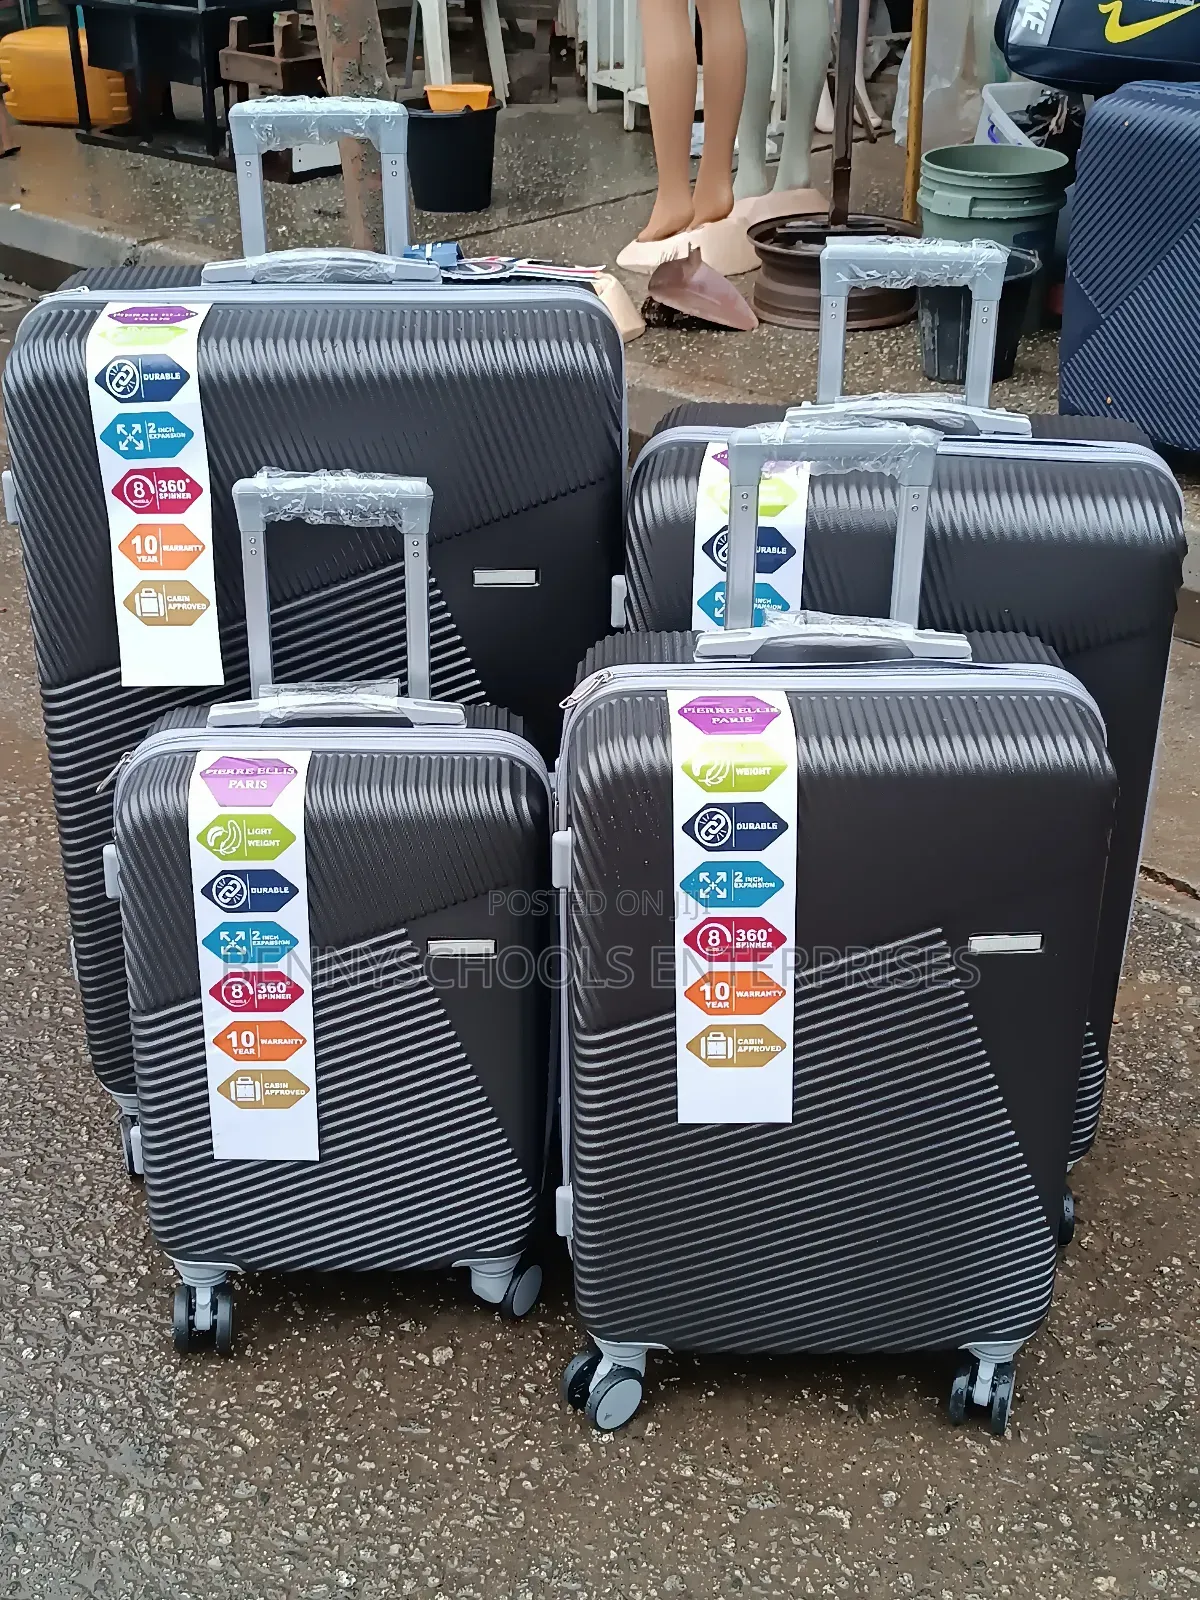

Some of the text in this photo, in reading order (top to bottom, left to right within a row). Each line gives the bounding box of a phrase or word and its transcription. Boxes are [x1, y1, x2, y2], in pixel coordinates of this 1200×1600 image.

[1021, 0, 1051, 35] KE
[143, 372, 181, 381] DURABLE
[148, 422, 157, 433] 2
[148, 432, 186, 440] EXPANSION
[133, 481, 146, 498] 8
[158, 492, 192, 500] SPINNER
[131, 535, 158, 555] 10
[162, 544, 203, 552] WARRANTY
[756, 546, 787, 554] URABLE
[136, 555, 158, 563] YEAR
[168, 602, 207, 610] APPROVED
[683, 706, 735, 714] PIERRE
[711, 716, 754, 724] PARIS
[205, 767, 255, 775] PIERRE
[735, 767, 772, 776] WEIGHT
[228, 779, 268, 789] PARIS
[736, 822, 778, 830] DURABLE
[734, 871, 743, 883] 2
[252, 930, 261, 941] 2
[707, 929, 721, 947] 8
[735, 941, 773, 949] SPINNER
[231, 983, 244, 999] 8
[699, 983, 730, 1001] 10
[705, 1001, 730, 1009] YEAR
[226, 1031, 255, 1048] 10
[737, 1045, 782, 1053] APPROVED
